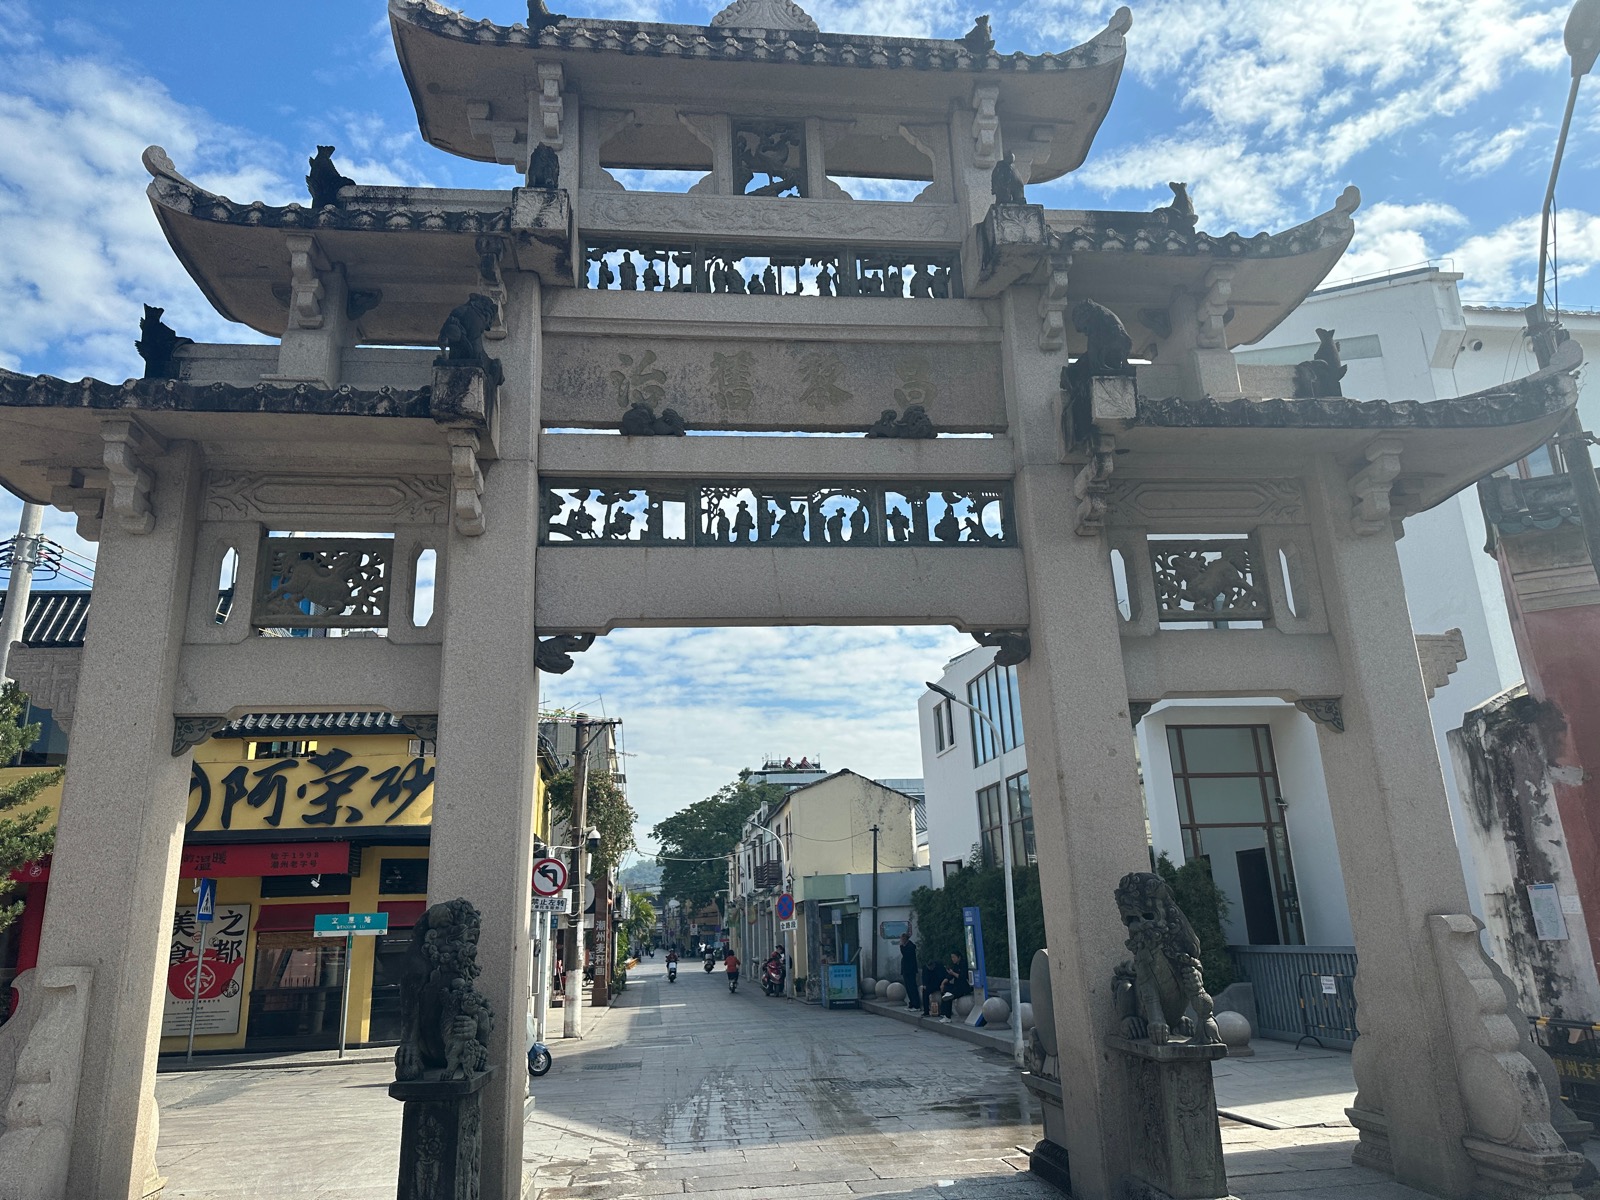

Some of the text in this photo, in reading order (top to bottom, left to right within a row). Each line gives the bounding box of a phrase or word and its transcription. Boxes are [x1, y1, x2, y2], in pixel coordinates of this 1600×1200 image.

[532, 898, 565, 906] 禁止左转
[595, 920, 606, 976] 潮州麦秆画
